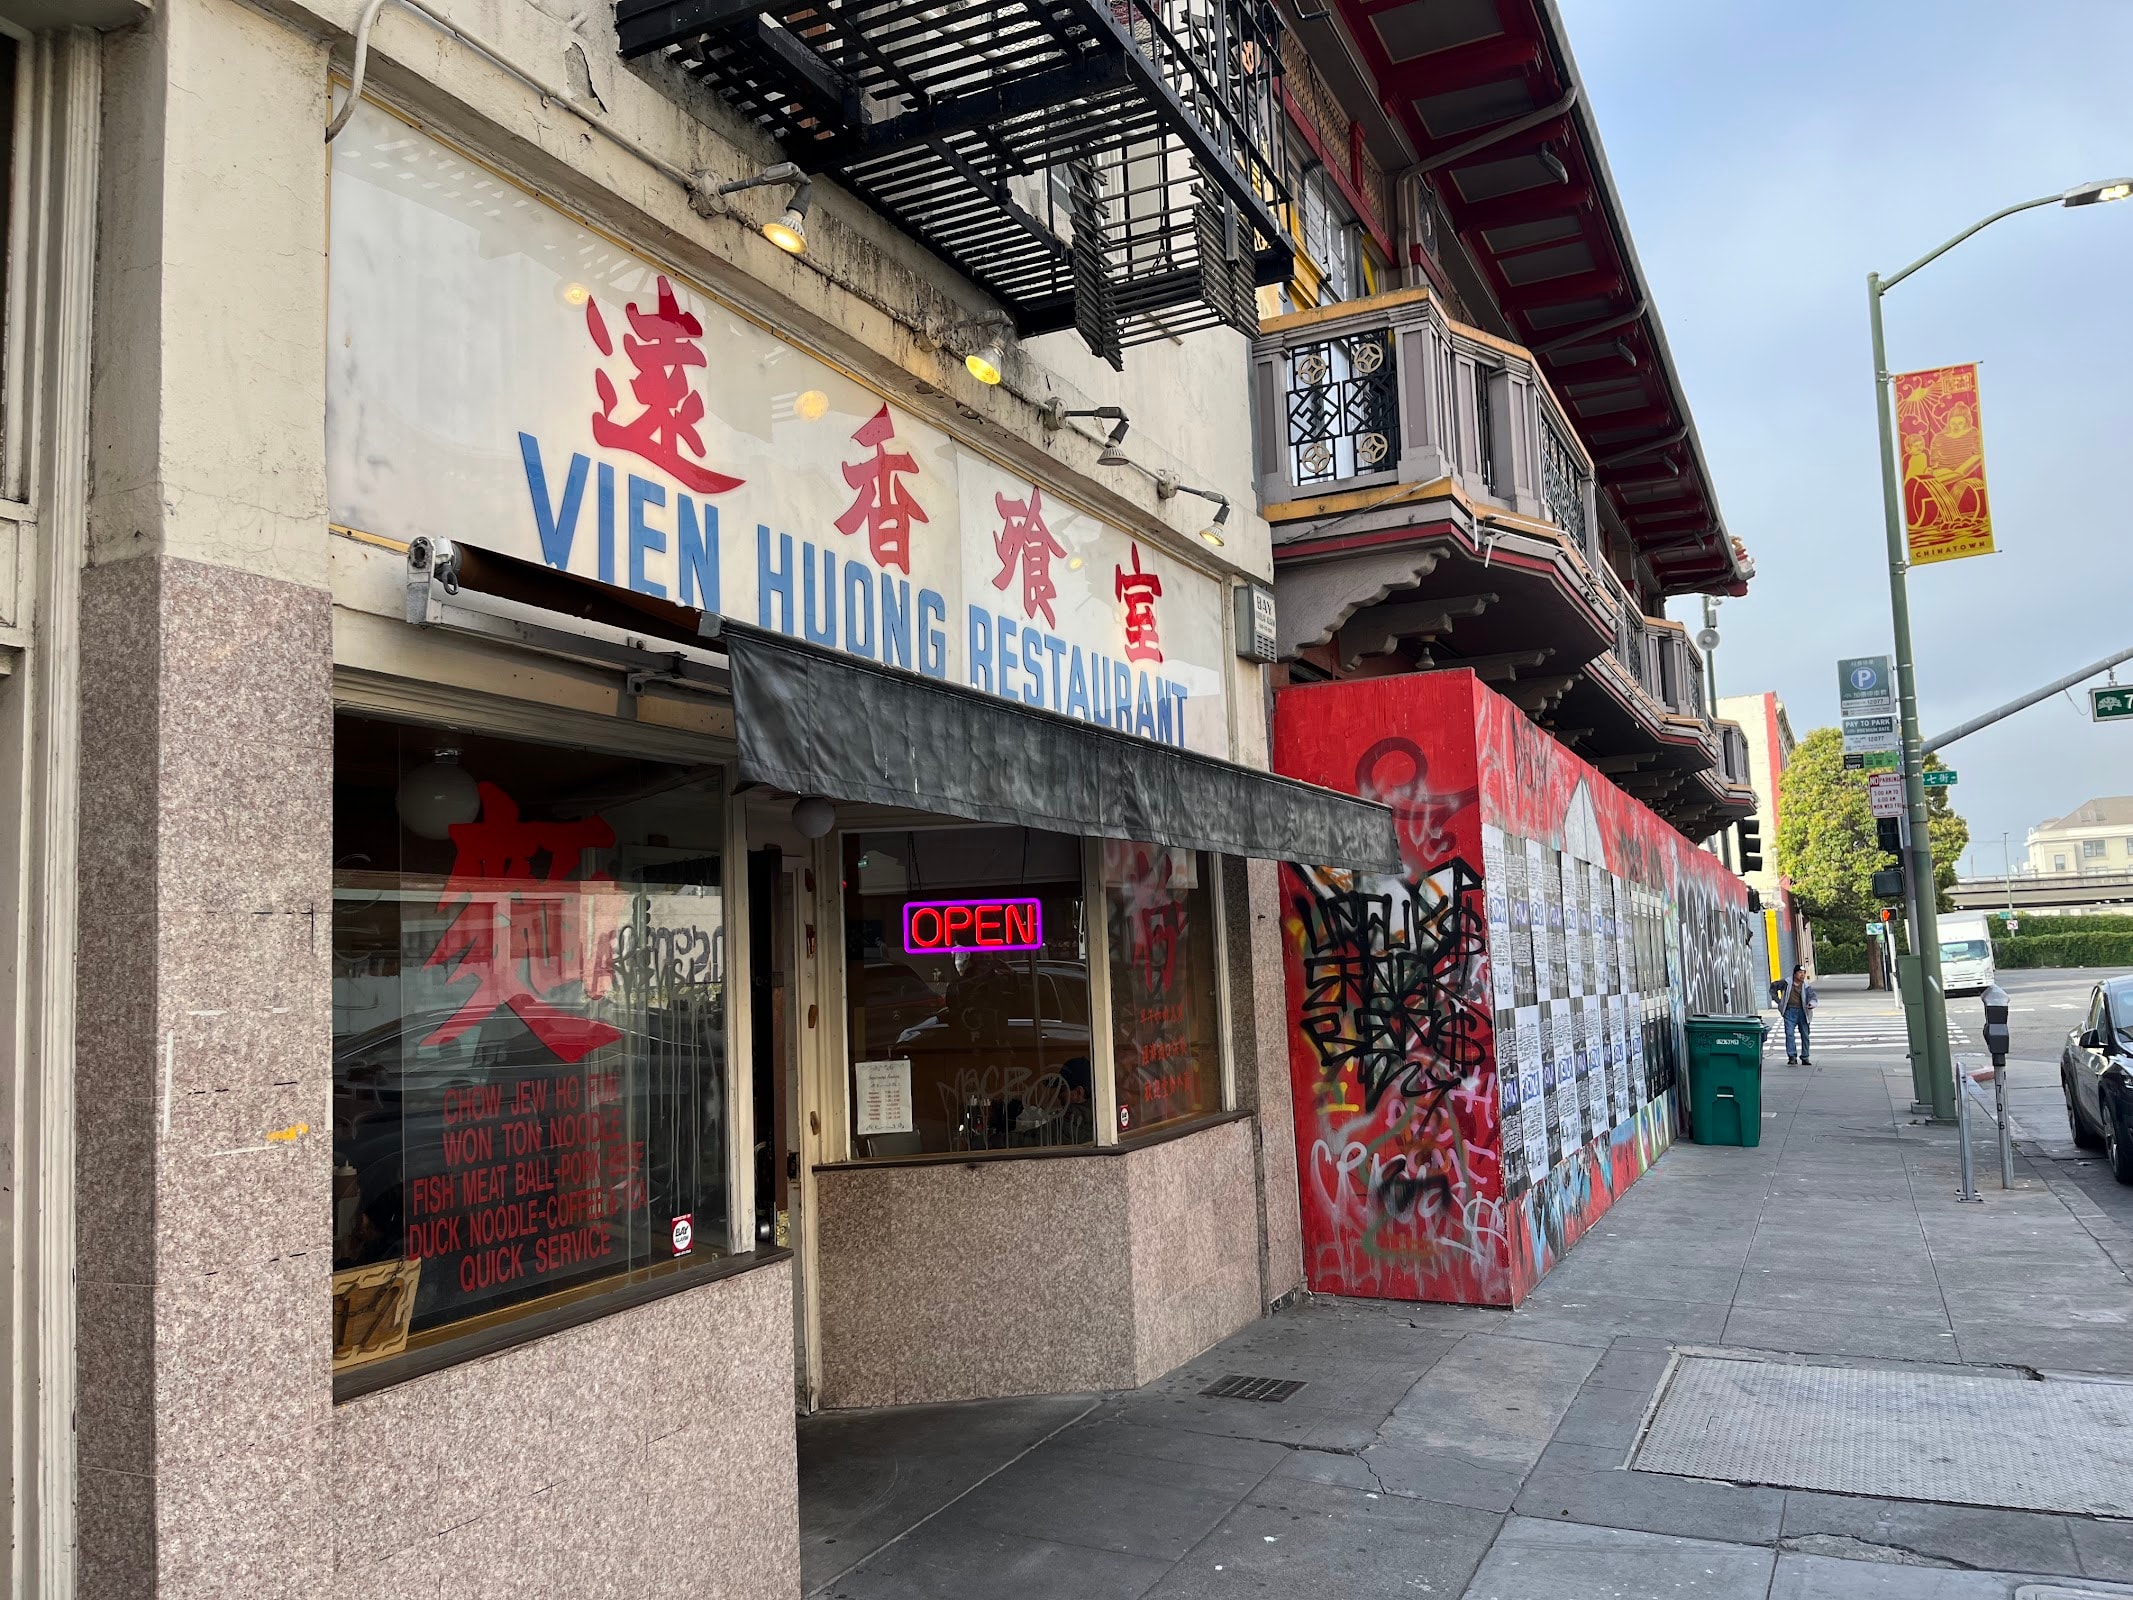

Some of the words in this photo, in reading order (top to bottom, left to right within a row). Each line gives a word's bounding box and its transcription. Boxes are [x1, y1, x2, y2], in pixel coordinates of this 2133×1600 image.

[1916, 541, 1986, 559] CHINATOWN
[519, 431, 720, 613] VIEN
[757, 523, 946, 681] HUONG
[968, 603, 1188, 749] RESTAURANT
[1256, 595, 1272, 615] BAY
[1845, 720, 1859, 728] PAY
[1860, 719, 1870, 727] TO
[1871, 718, 1891, 726] PARK
[1869, 776, 1879, 786] NO
[1879, 775, 1900, 783] PARKING
[1923, 773, 1949, 784] 七街
[911, 903, 1036, 948] OPEN
[443, 1084, 501, 1125] CHOW
[510, 1079, 548, 1117] JEW
[555, 1076, 579, 1109] HO
[442, 1127, 493, 1167] WON
[501, 1120, 541, 1157] TON
[550, 1109, 622, 1149] NOODLE
[412, 1176, 455, 1217] FISH
[462, 1165, 508, 1206] MEAT
[409, 1216, 461, 1261] DUCK
[675, 1226, 689, 1237] BAY
[460, 1243, 524, 1293] QUICK
[535, 1222, 613, 1274] SERVICE
